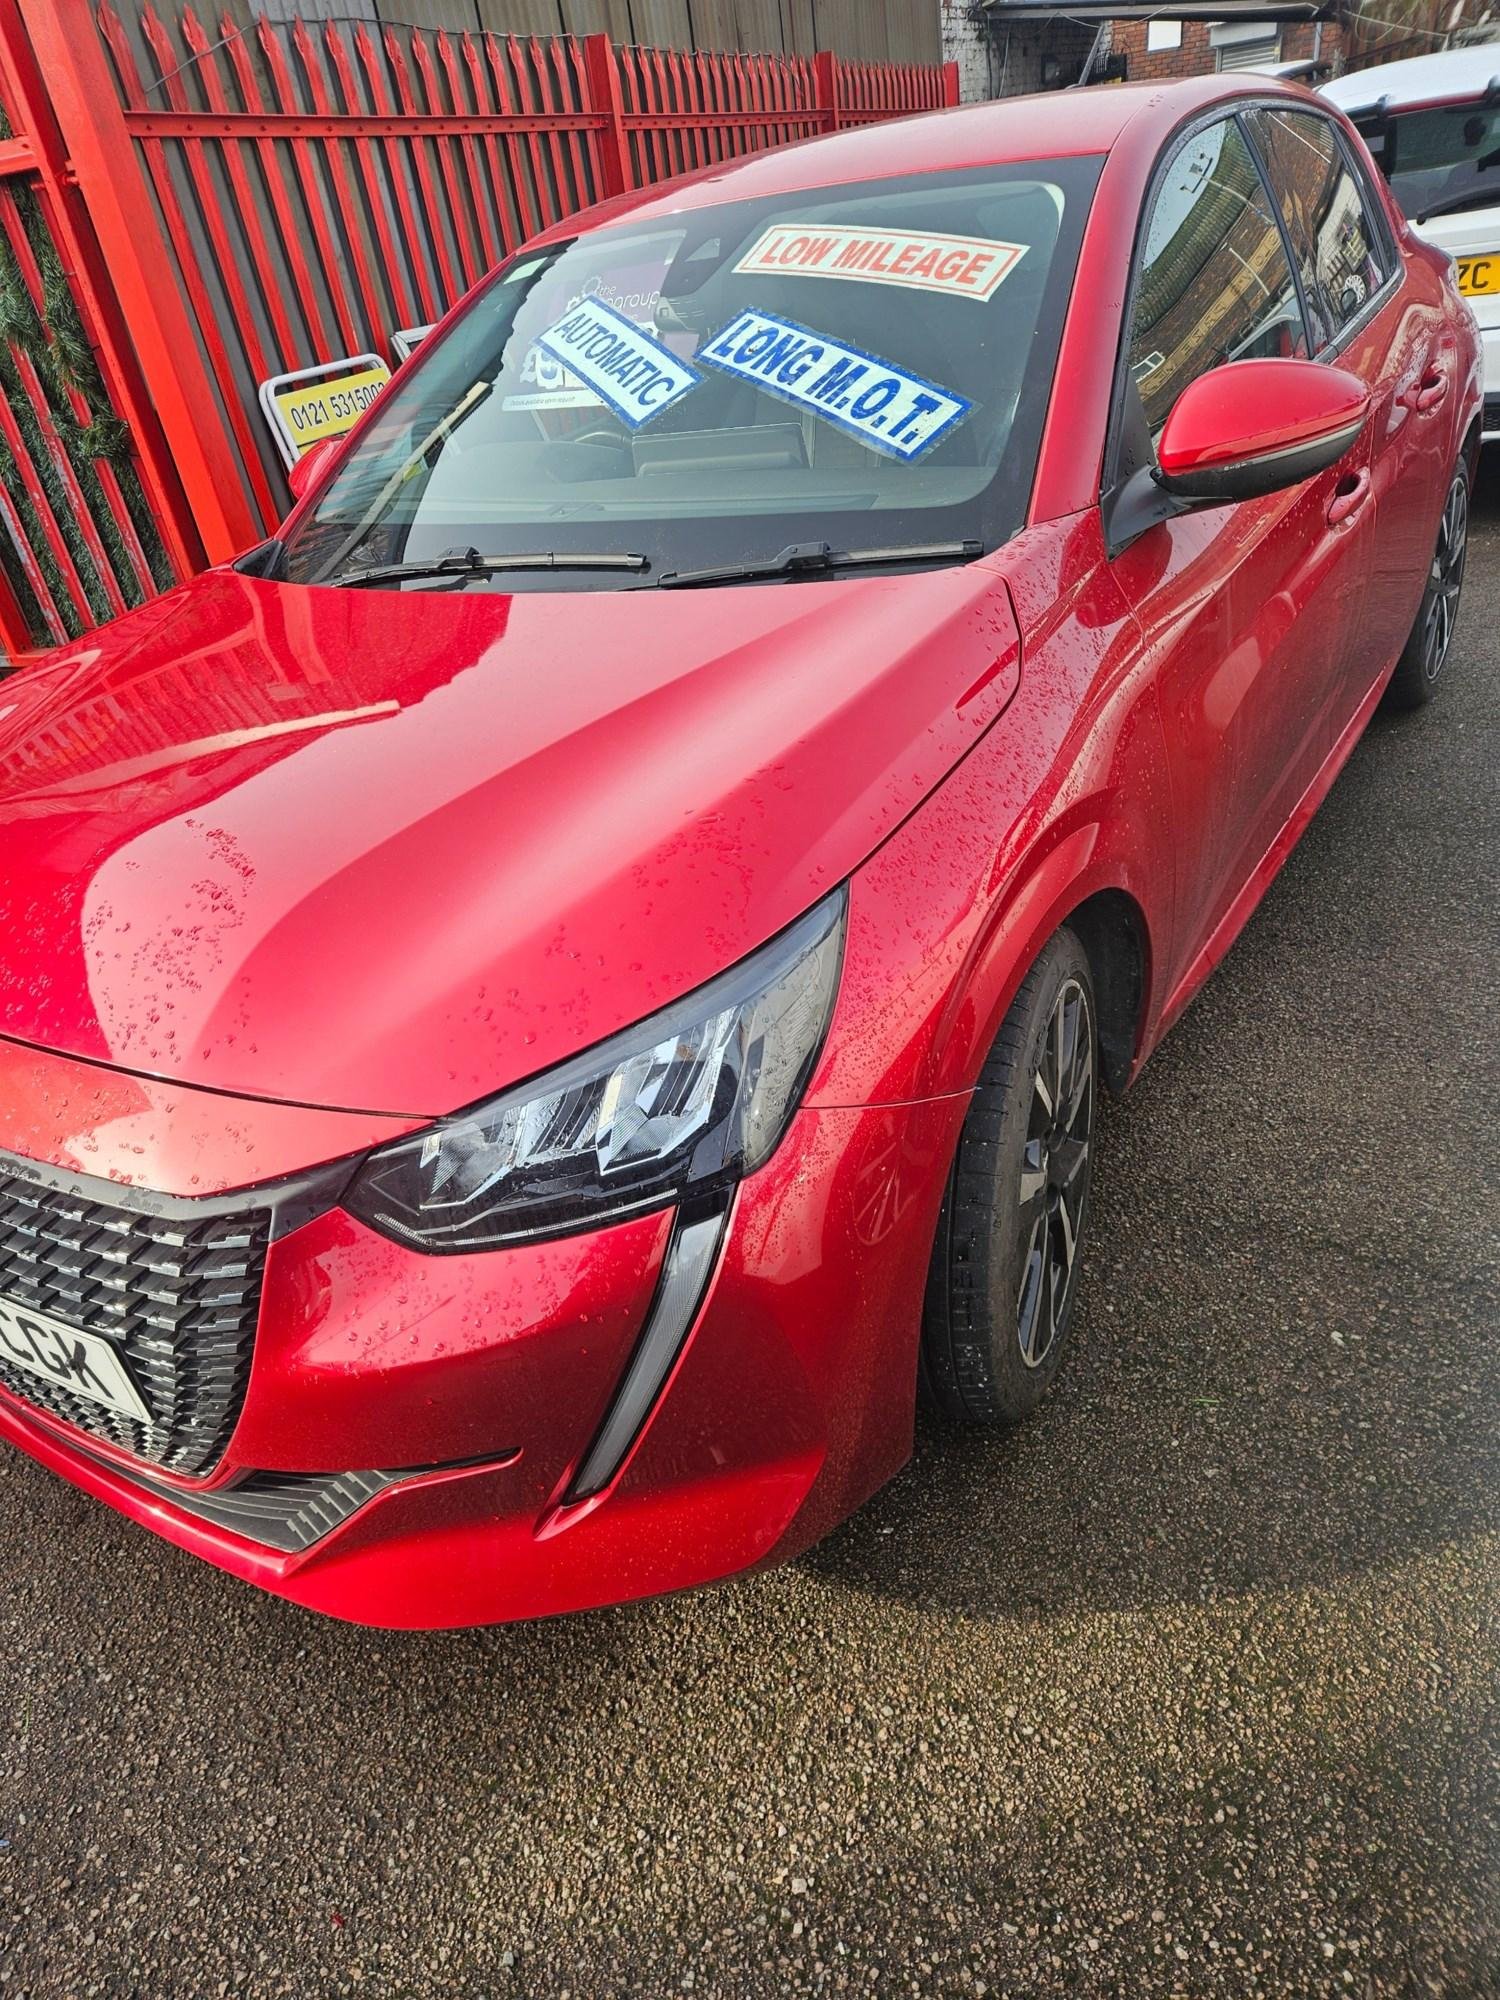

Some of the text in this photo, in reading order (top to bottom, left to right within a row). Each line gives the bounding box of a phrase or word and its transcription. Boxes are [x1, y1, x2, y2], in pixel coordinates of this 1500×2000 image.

[759, 236, 996, 285] LOW MILEAGE
[553, 313, 676, 406] AUTOMATIC
[711, 318, 943, 445] LONG M.O.T.
[291, 399, 330, 430] 0121
